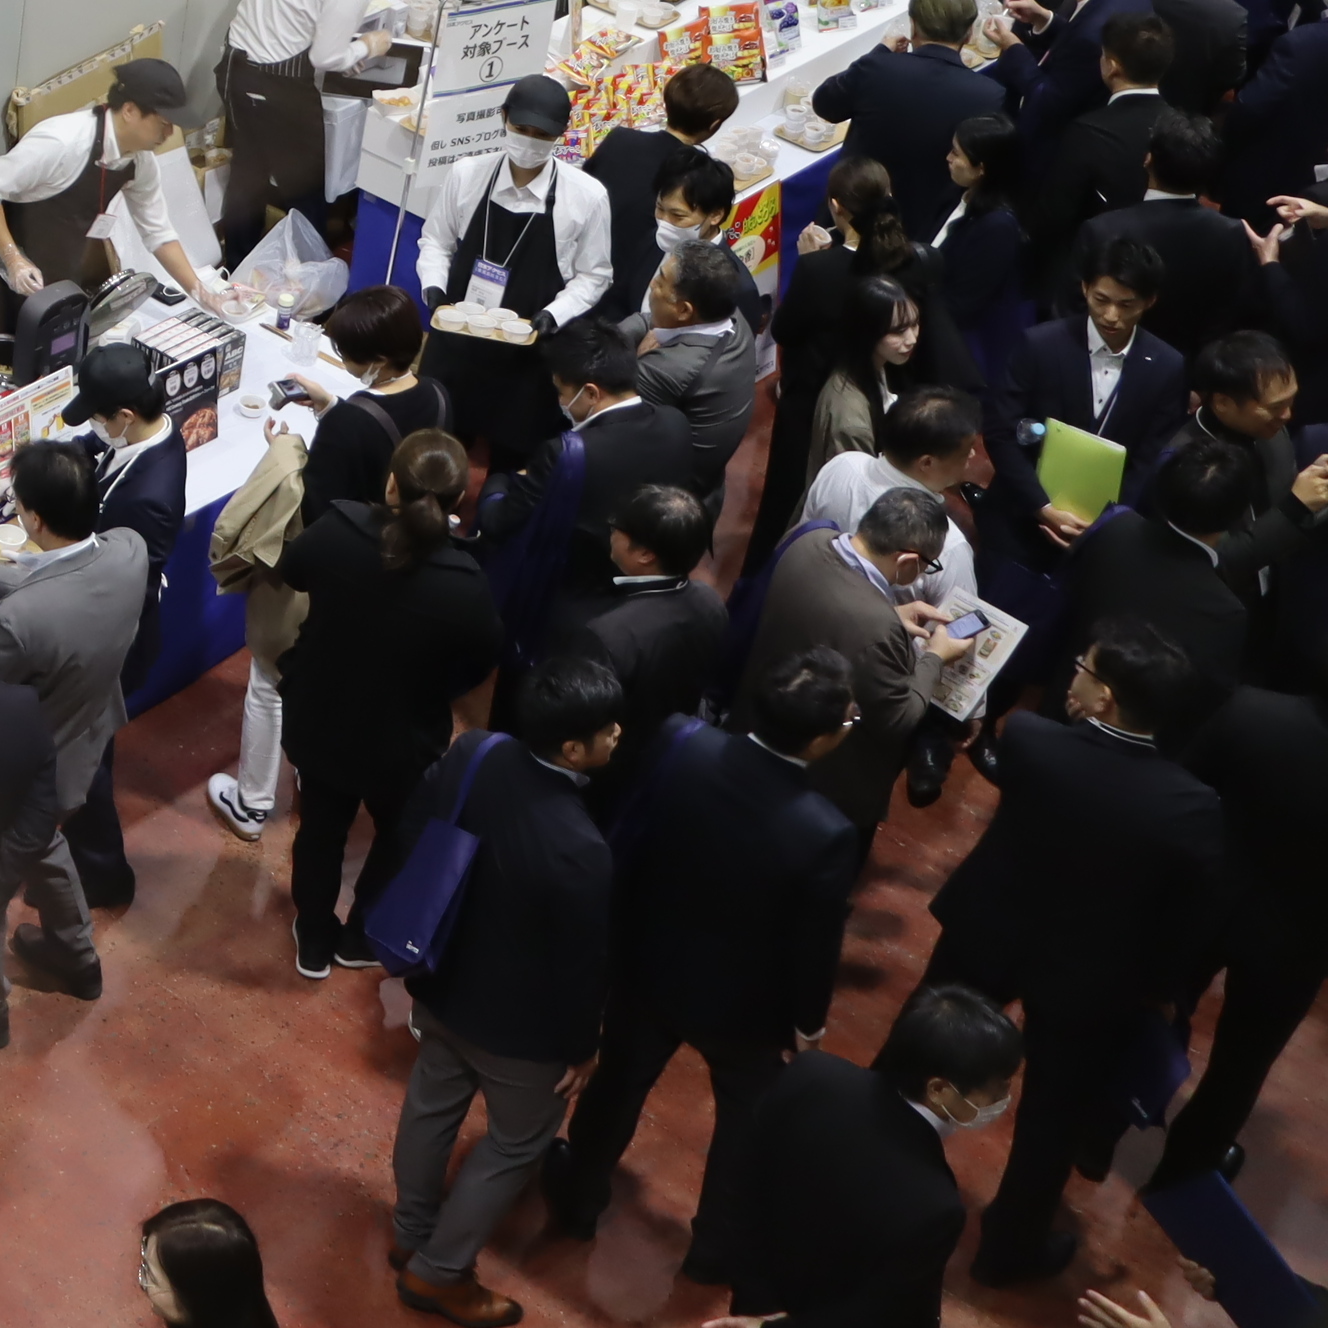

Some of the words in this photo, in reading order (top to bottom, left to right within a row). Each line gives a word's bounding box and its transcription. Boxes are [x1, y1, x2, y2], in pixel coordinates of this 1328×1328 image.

[469, 14, 530, 41] アンケート
[460, 34, 530, 61] 対象ブース
[430, 140, 447, 152] 但し
[224, 346, 244, 362] ABC
